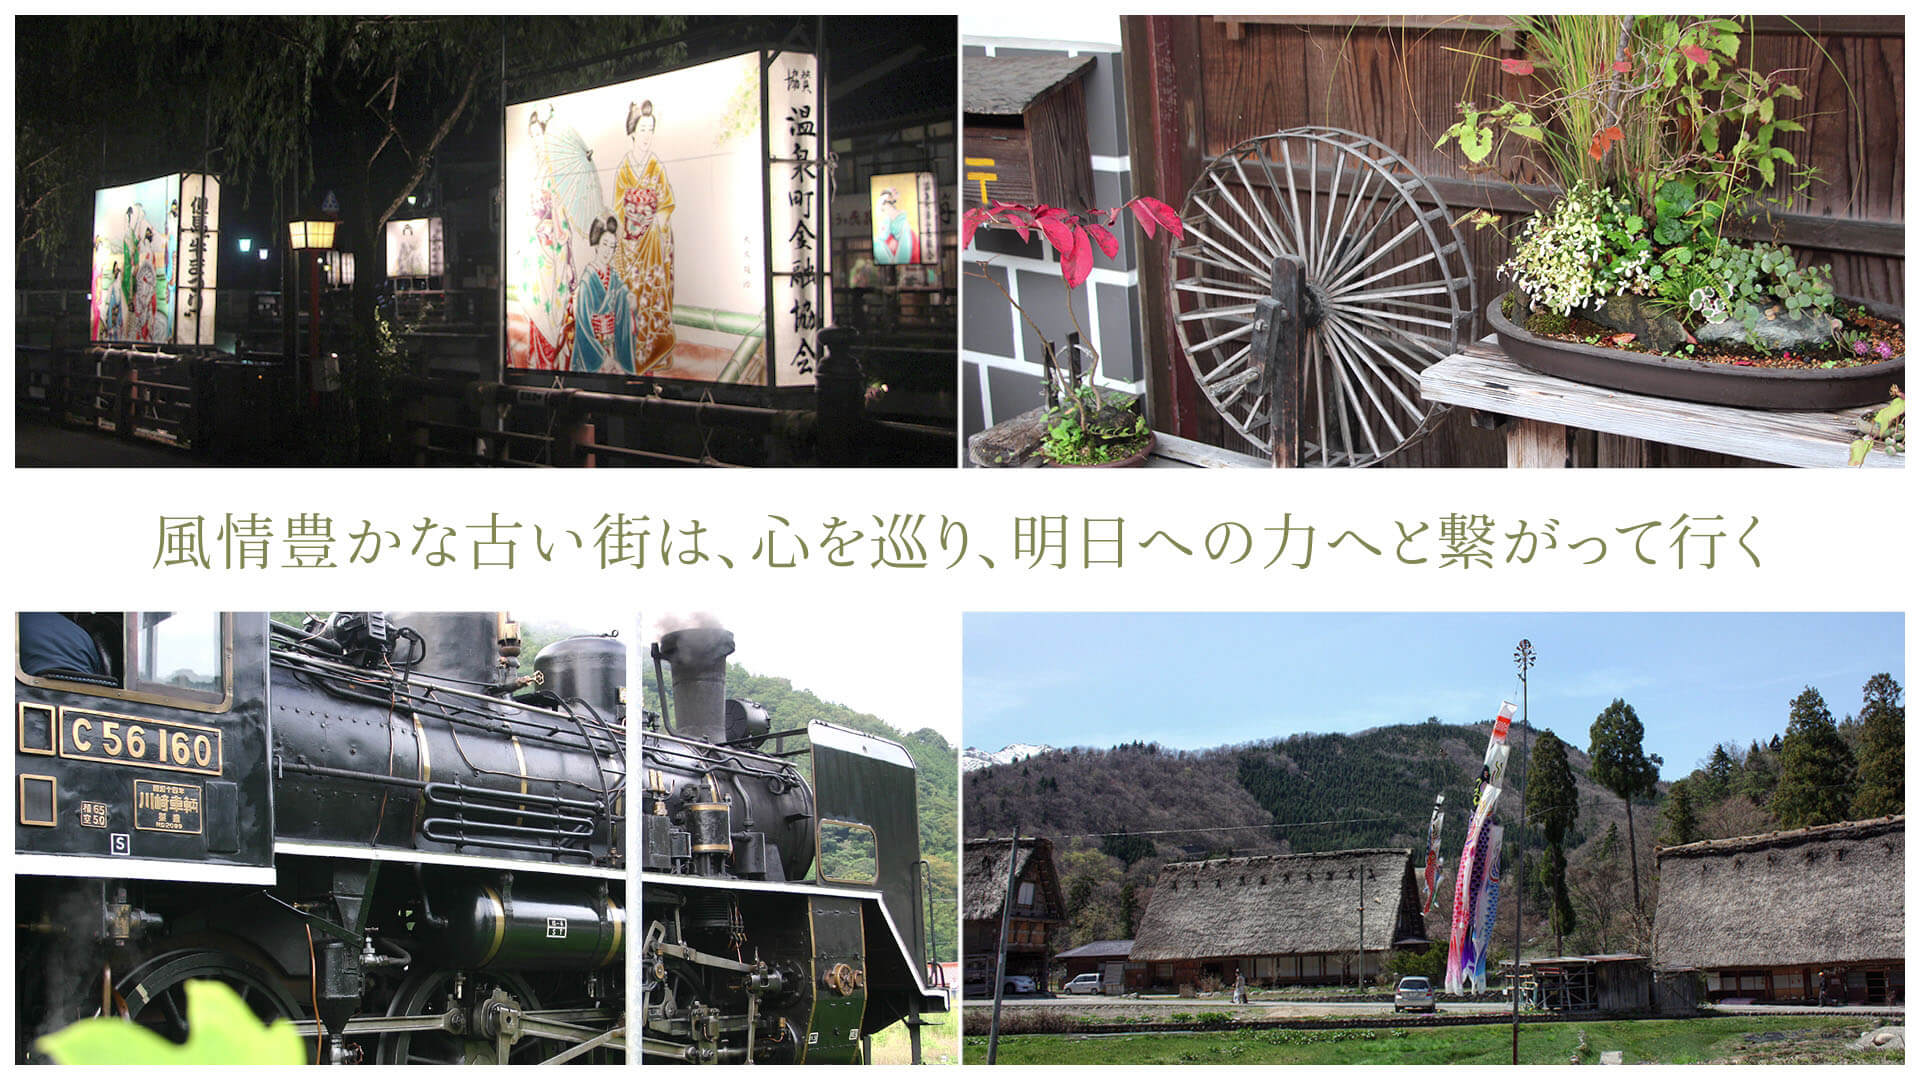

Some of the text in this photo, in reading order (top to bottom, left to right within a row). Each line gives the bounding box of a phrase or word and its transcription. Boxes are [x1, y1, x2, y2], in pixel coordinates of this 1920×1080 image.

[786, 105, 816, 375] 温泉町金融協会
[159, 729, 211, 767] 160
[115, 837, 125, 850] S
